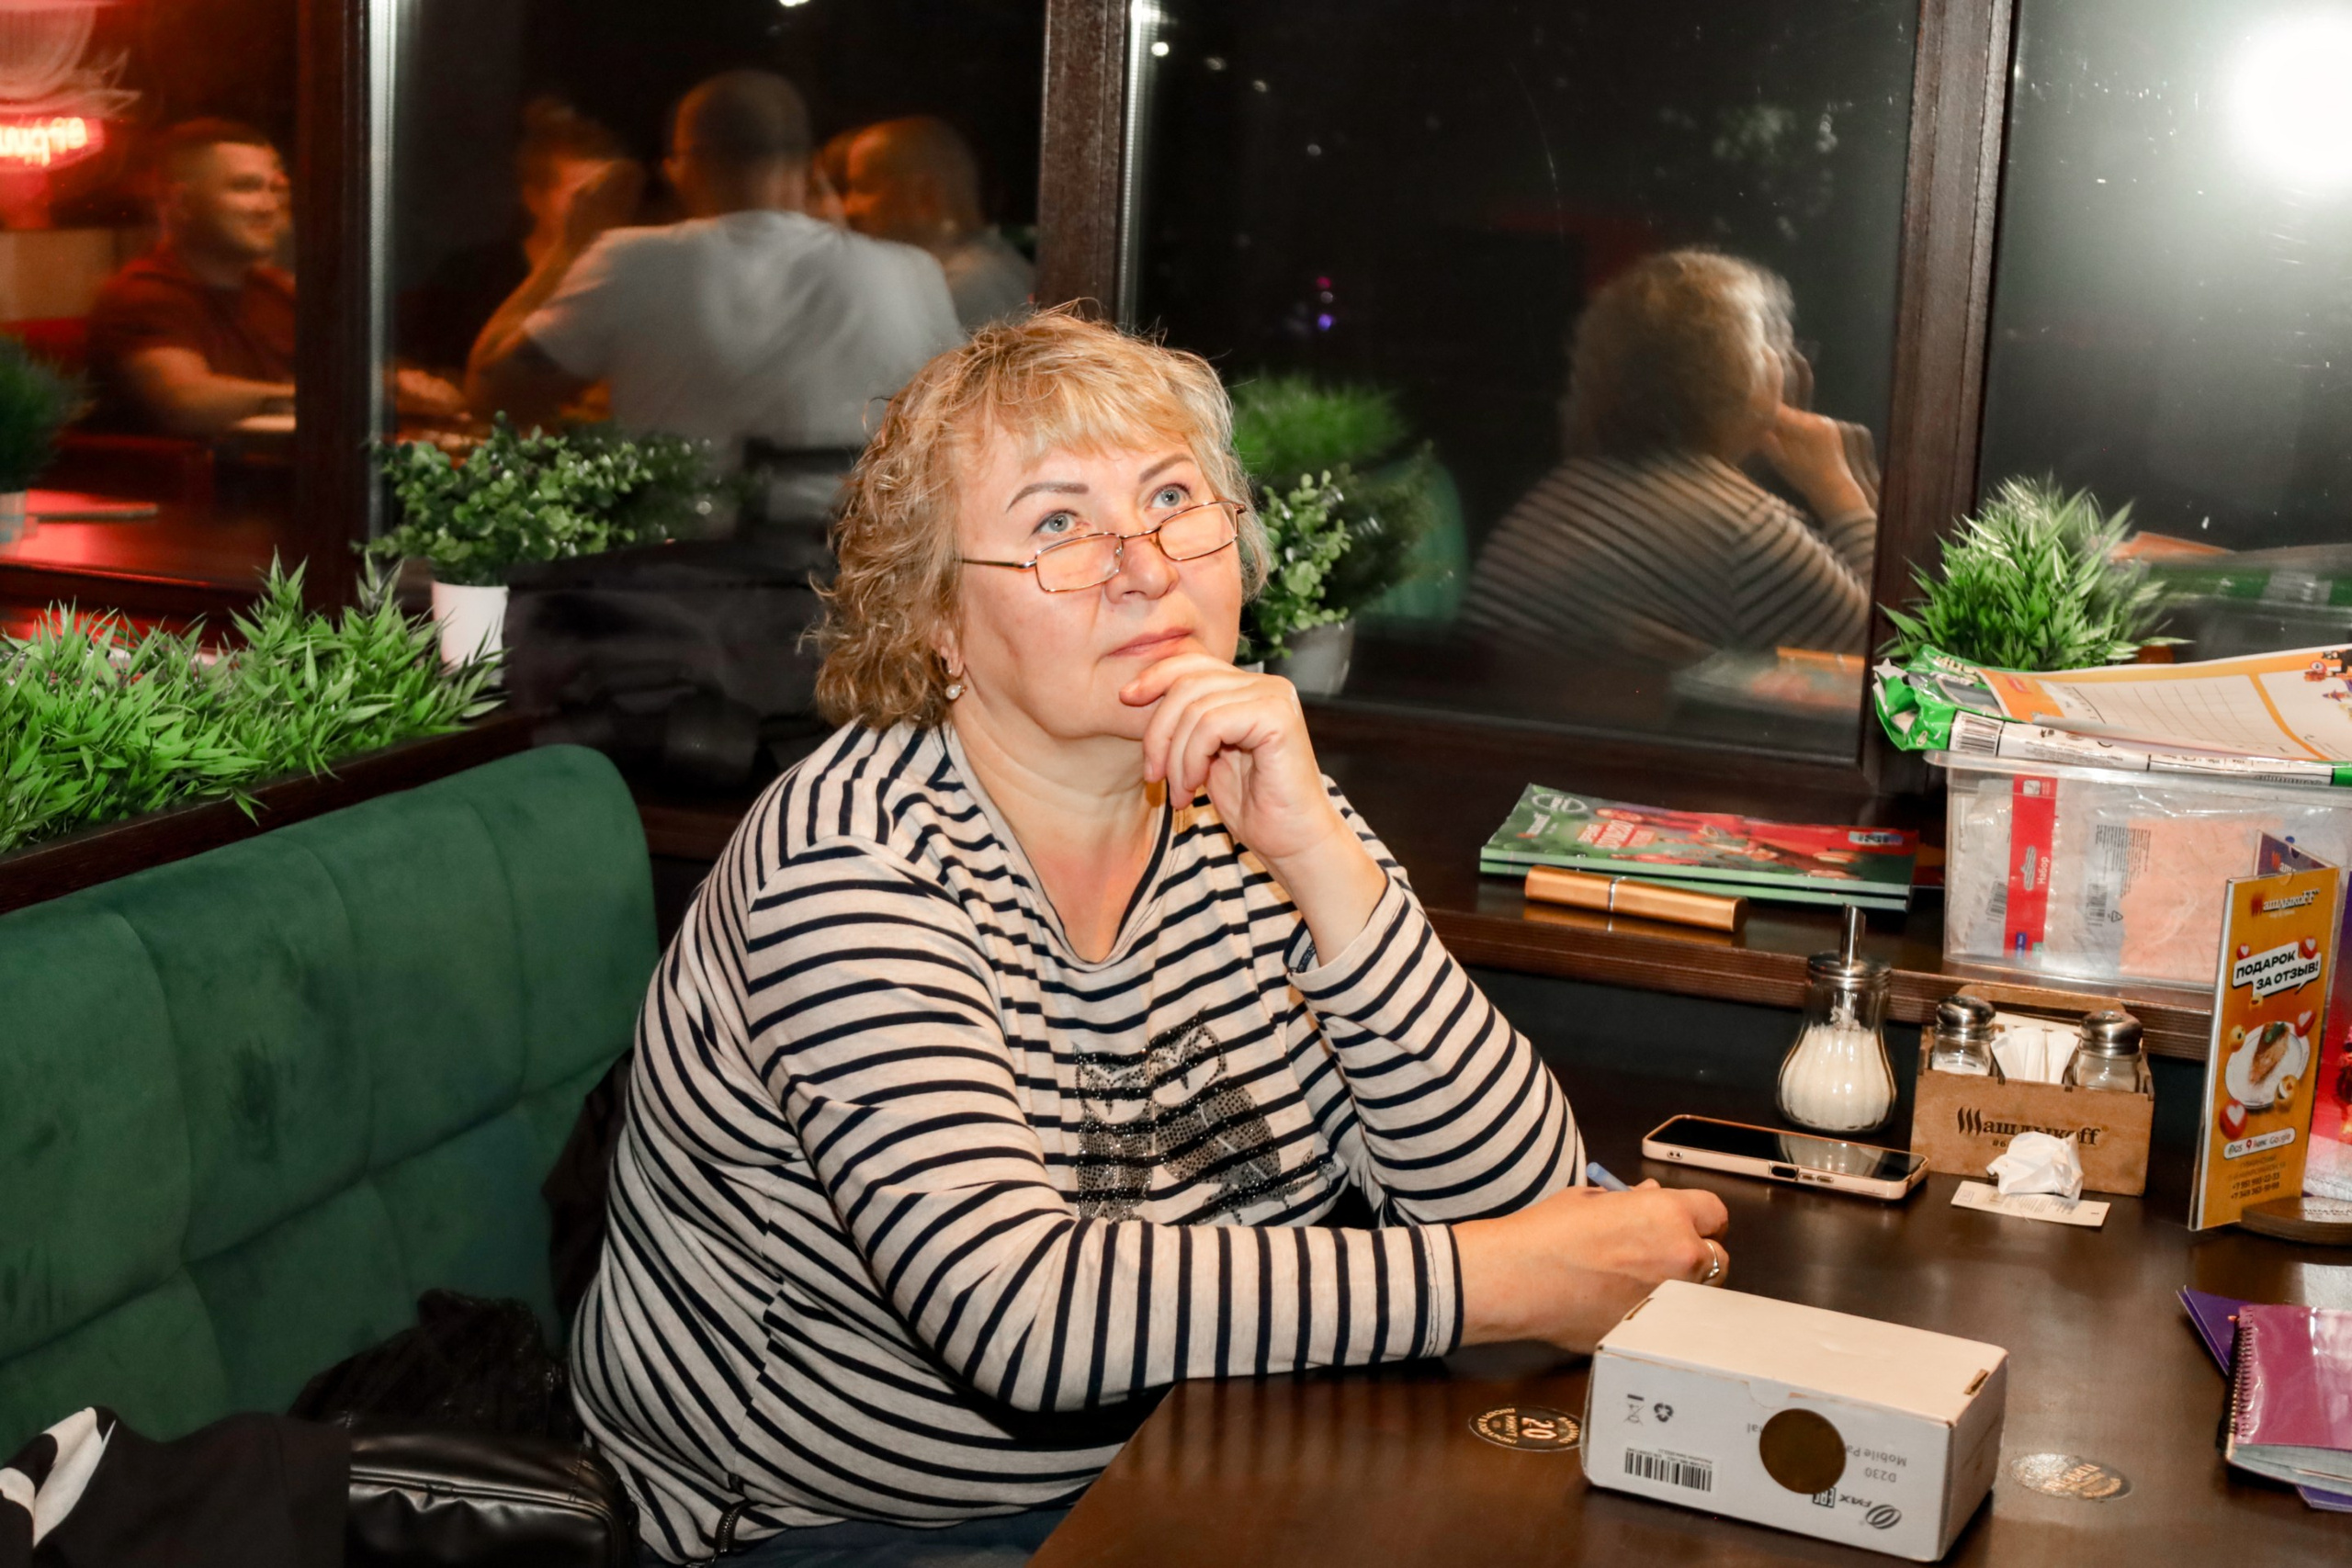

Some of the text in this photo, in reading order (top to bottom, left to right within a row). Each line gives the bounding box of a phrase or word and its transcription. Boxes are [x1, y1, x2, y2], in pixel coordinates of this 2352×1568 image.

[2037, 856, 2050, 885] Набор
[2236, 950, 2295, 979] ПОДАРОК
[2256, 961, 2319, 990] ЗА ОТЗЫВ!
[1521, 1417, 1558, 1440] 20
[1863, 1448, 1907, 1467] Mobile
[1865, 1467, 1897, 1483] D230
[1838, 1494, 1872, 1507] PAX
